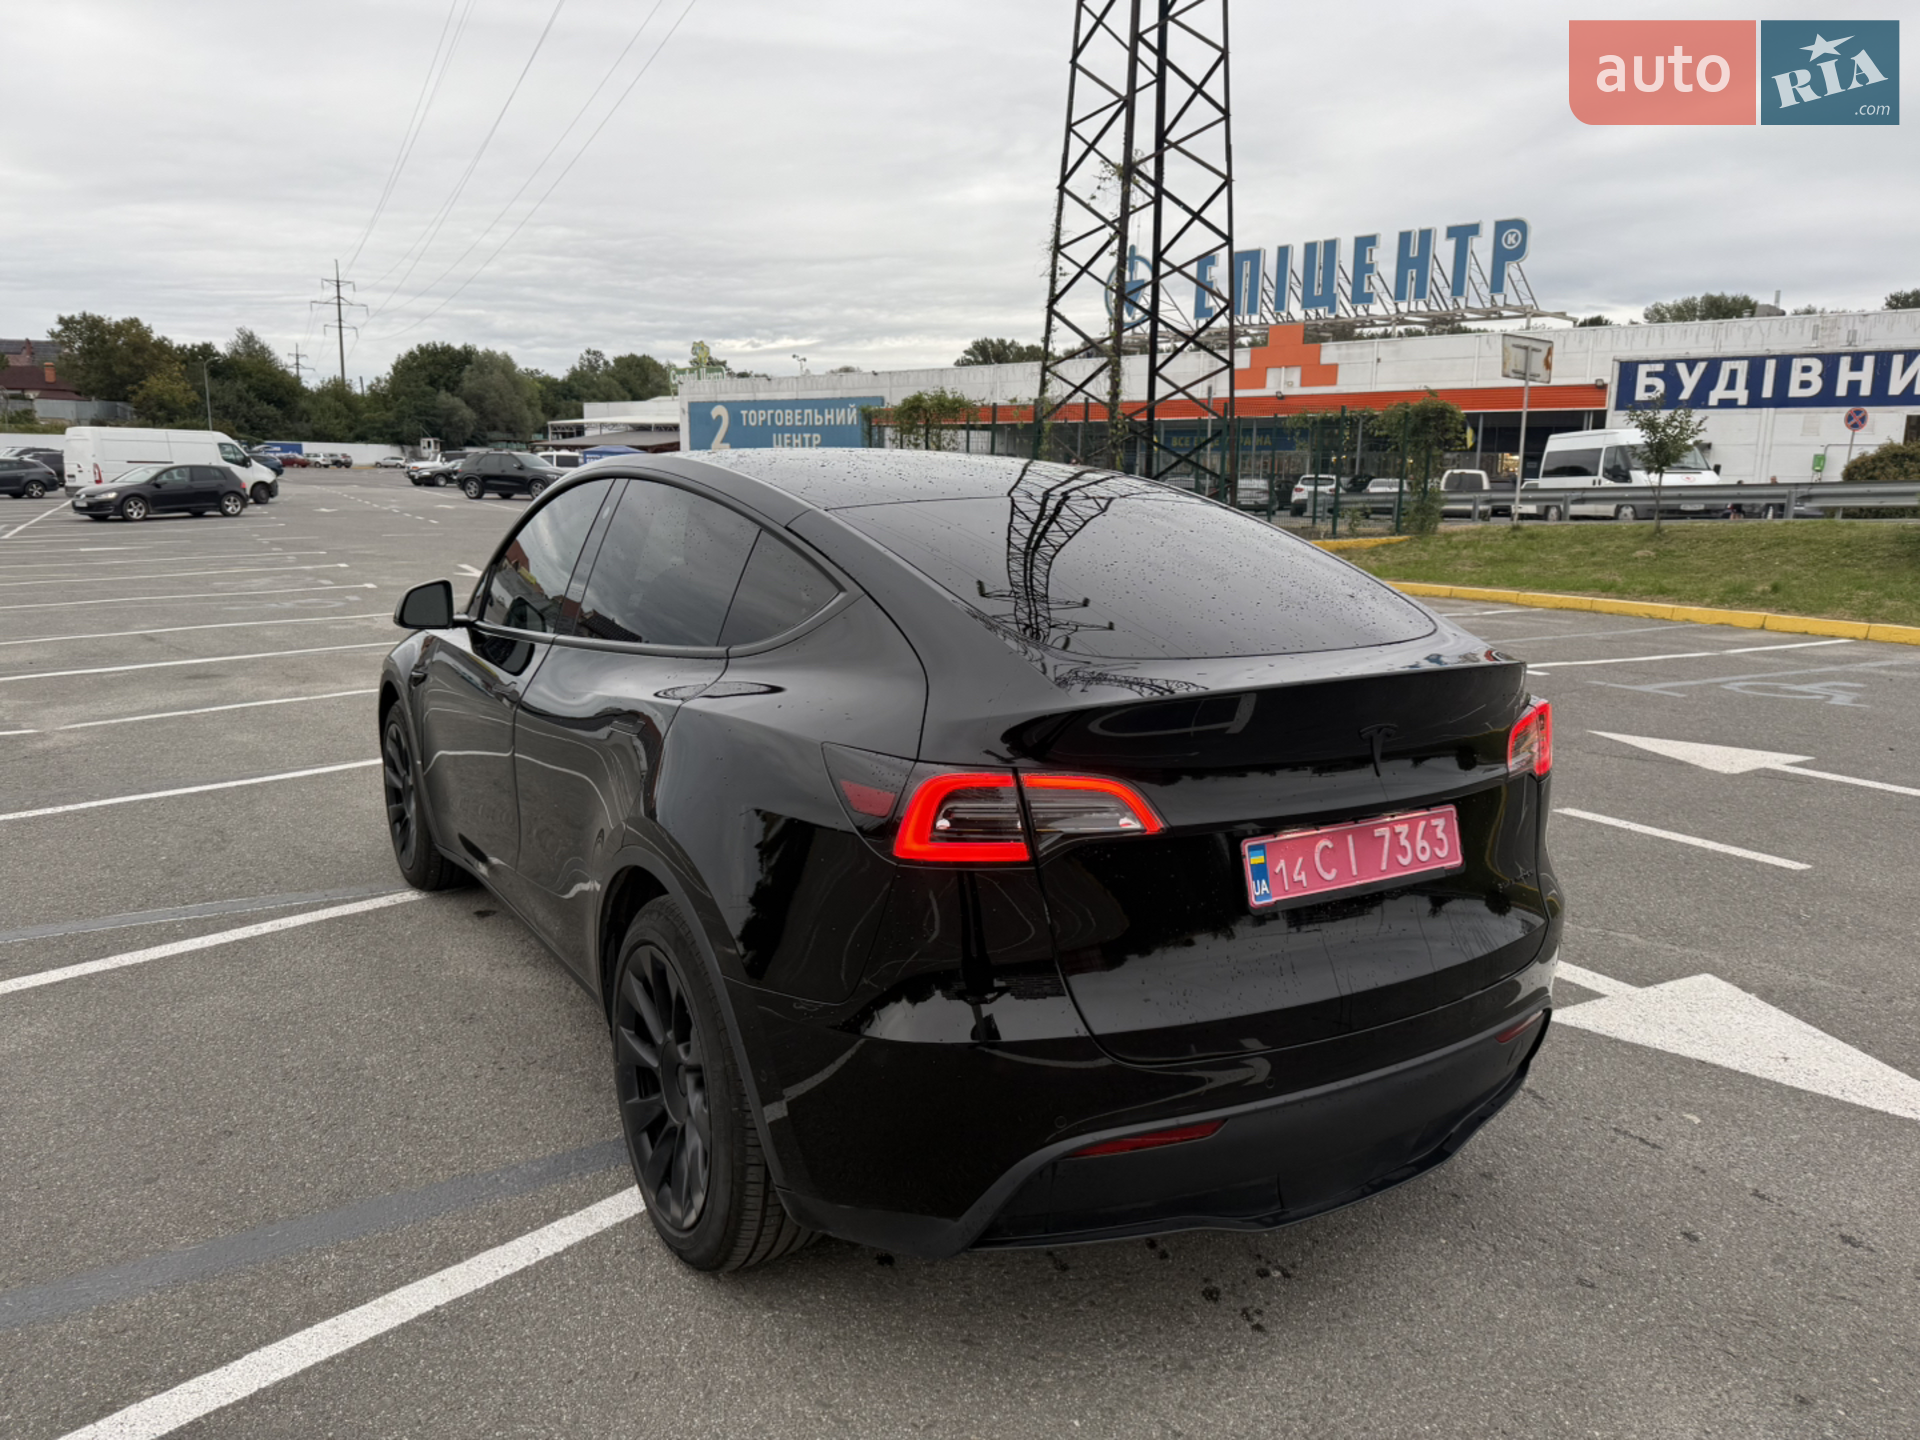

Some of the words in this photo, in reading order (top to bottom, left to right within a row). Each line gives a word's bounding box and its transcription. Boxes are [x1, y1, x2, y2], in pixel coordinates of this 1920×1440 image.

[1193, 217, 1531, 320] ЕПІЦЕНТР
[711, 404, 731, 450] 2
[740, 403, 858, 427] ТОРГОВЕЛЬНИЙ
[772, 433, 822, 448] ЦЕНТР
[1274, 856, 1308, 891] 14
[1373, 817, 1450, 873] 7363
[1252, 878, 1270, 896] UA
